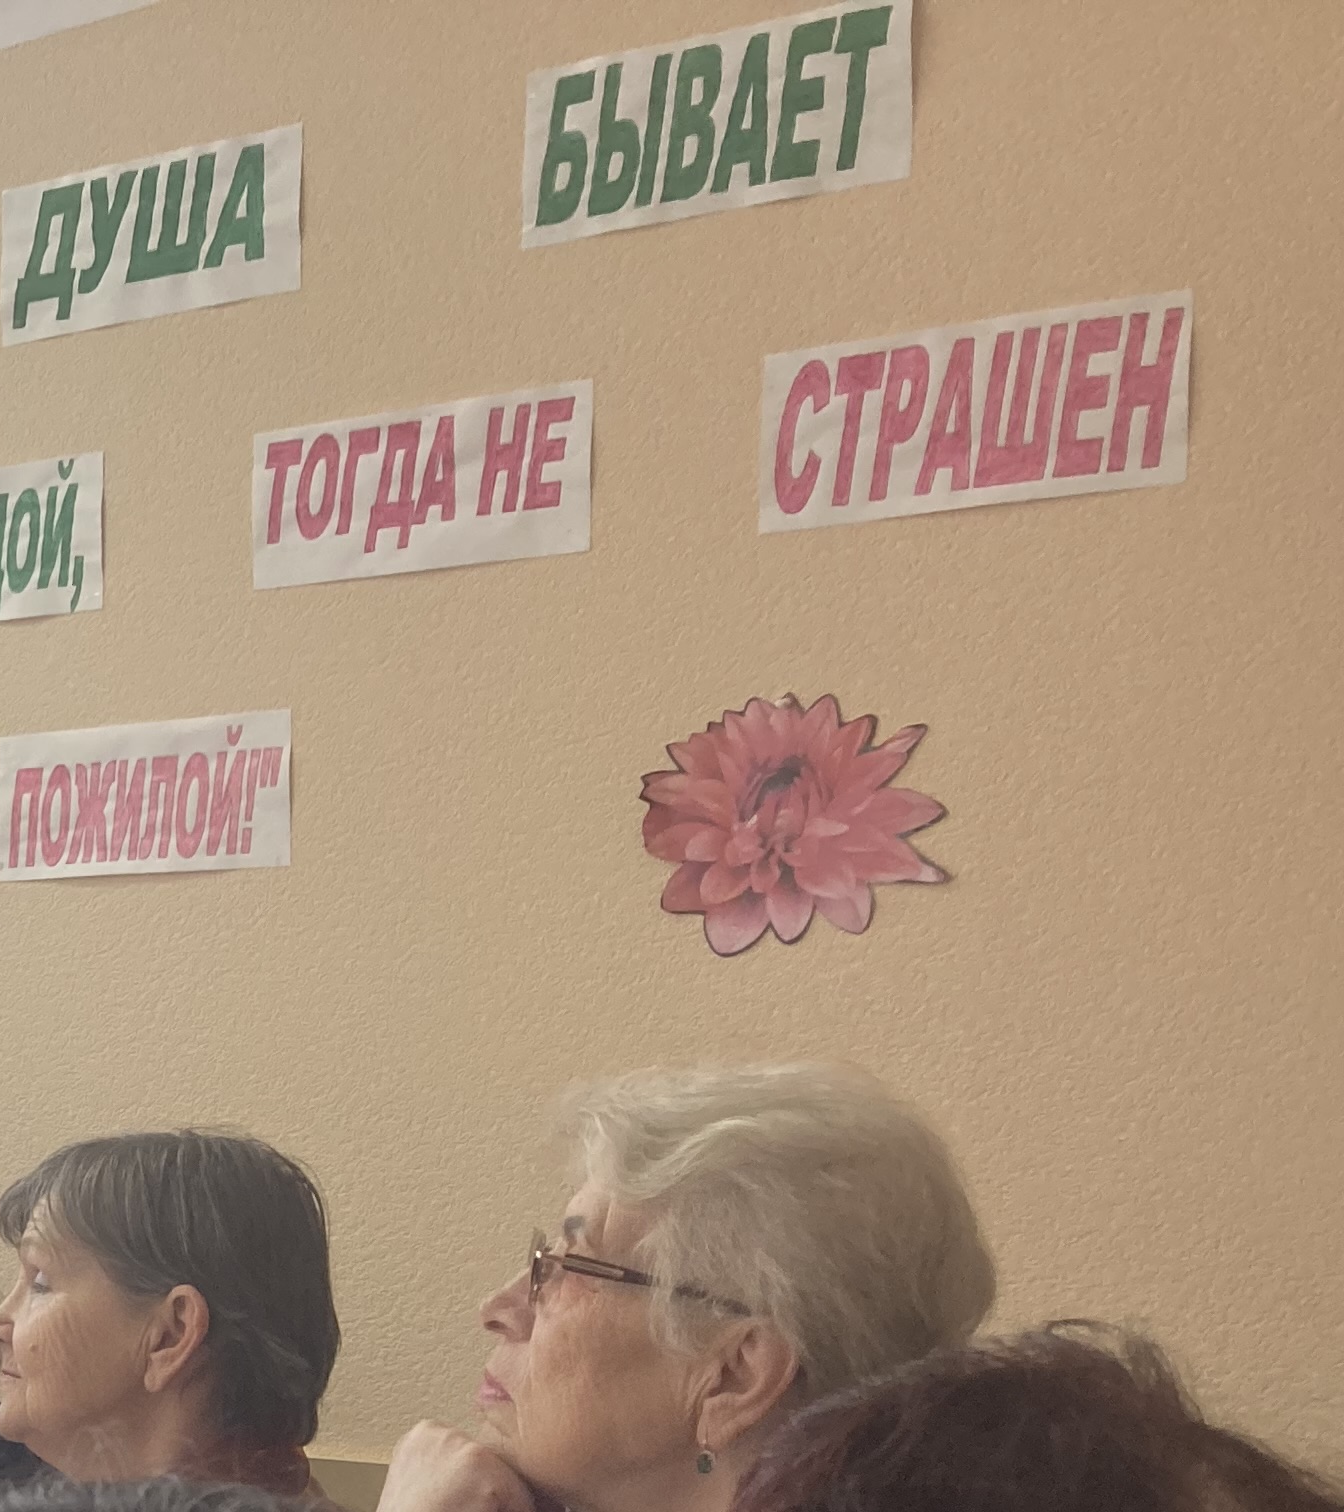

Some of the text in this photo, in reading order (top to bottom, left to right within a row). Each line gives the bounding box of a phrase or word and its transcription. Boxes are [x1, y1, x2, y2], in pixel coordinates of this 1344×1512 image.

[535, 5, 893, 226] БЫВАЕТ
[13, 144, 265, 328] ДУША
[265, 396, 576, 554] ТОГДА НЕ
[775, 307, 1185, 514] СТРАШЕН
[8, 725, 283, 869] ПОЖИЛОЙ!"
